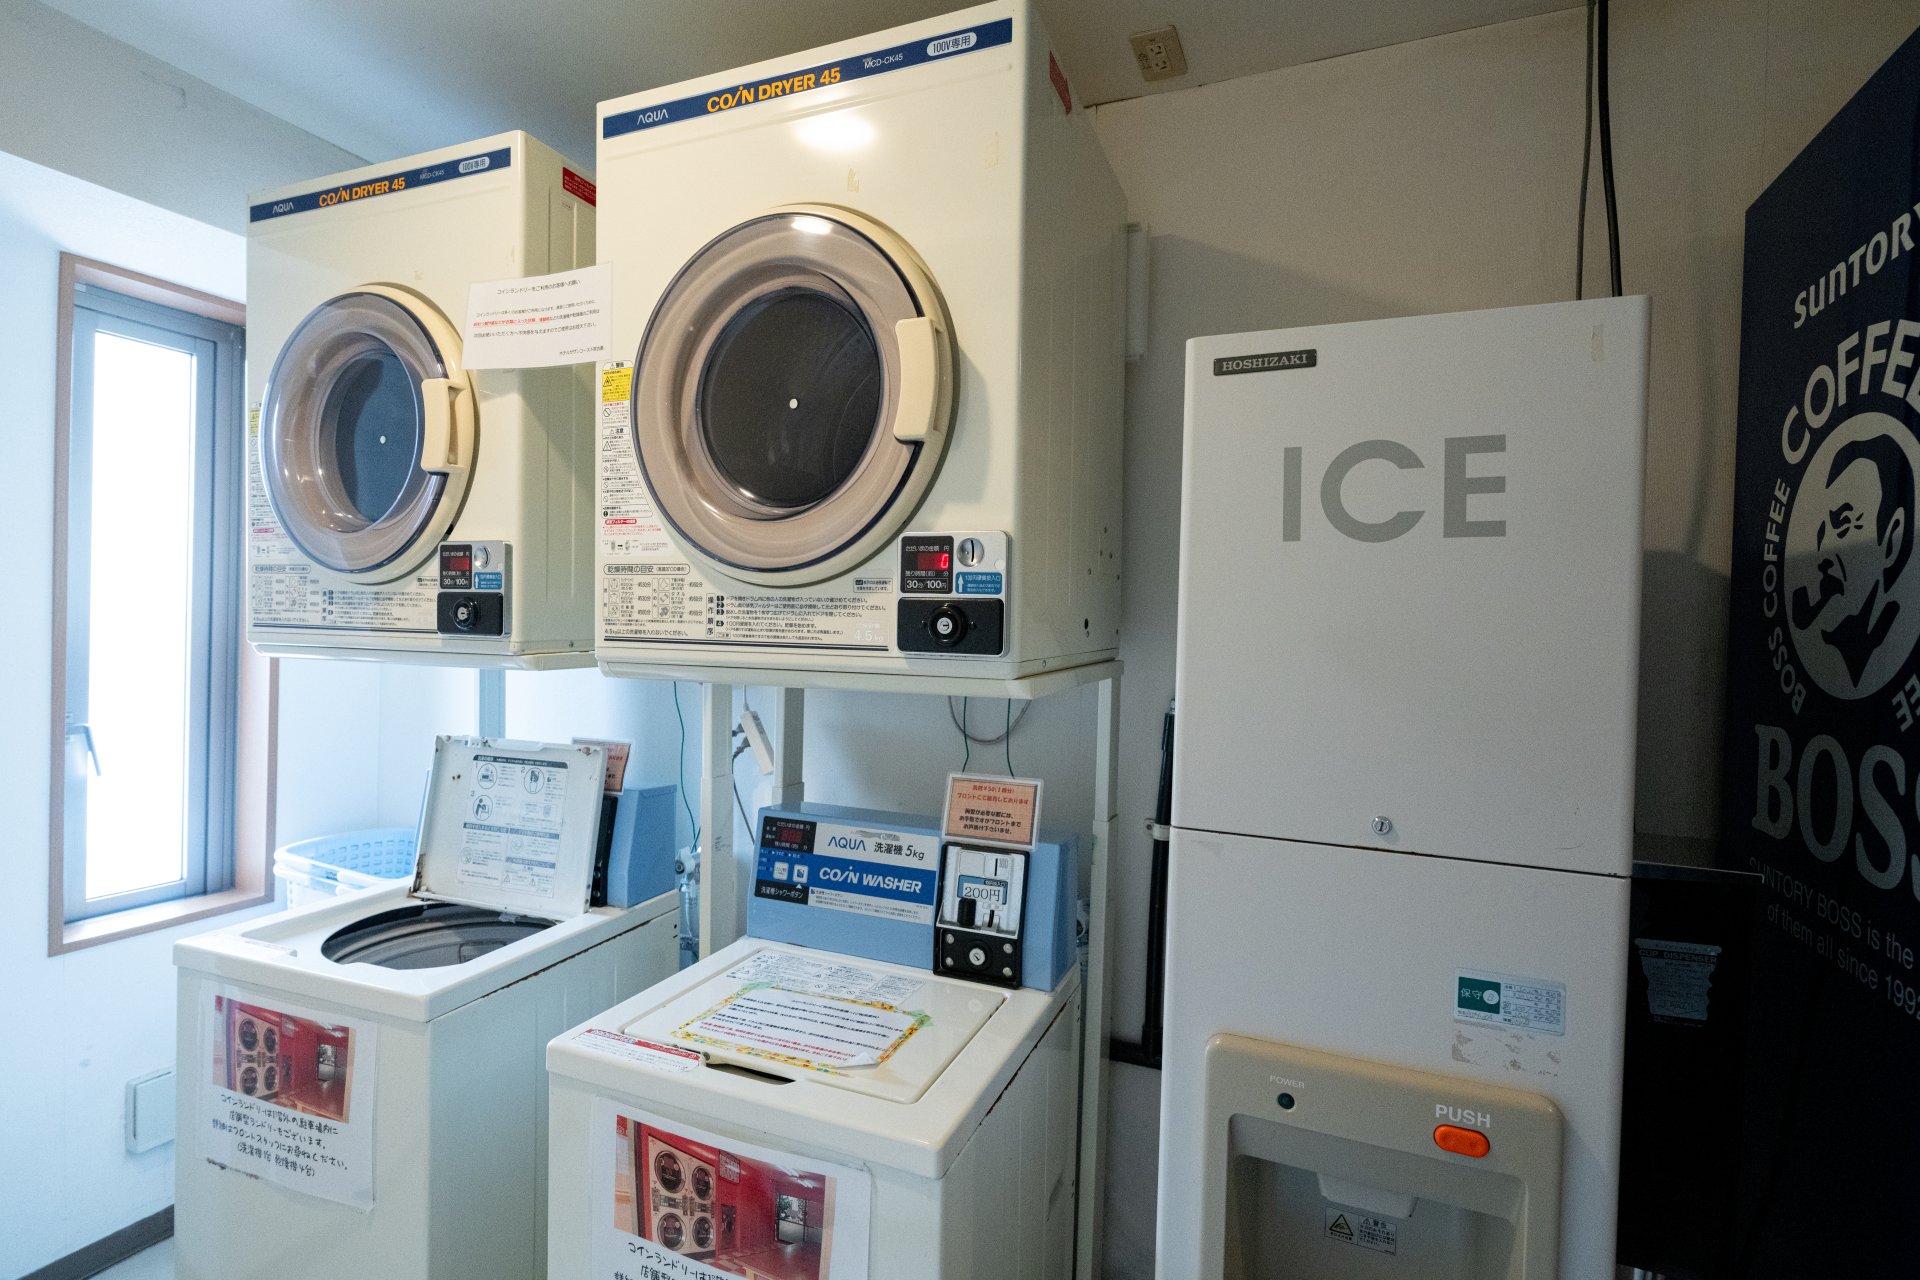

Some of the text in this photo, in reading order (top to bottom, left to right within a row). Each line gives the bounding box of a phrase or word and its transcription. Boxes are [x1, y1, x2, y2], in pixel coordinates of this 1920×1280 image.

[933, 35, 970, 54] 100V専用
[864, 53, 903, 69] MCD-CK45
[707, 67, 840, 112] COIN DRYER 45
[637, 108, 668, 126] AQUA
[319, 176, 405, 207] COIN DRYER 45
[272, 202, 294, 214] AQUA
[1222, 353, 1308, 372] HOSHIZAKI
[1282, 434, 1506, 543] ICE
[1762, 478, 1791, 618] COFFEE
[608, 566, 653, 574] 乾燥時間の目安
[941, 554, 949, 568] 0
[906, 580, 947, 589] 30分 100円
[1752, 724, 1920, 903] BOS
[828, 836, 866, 851] AQUA
[874, 842, 925, 861] 洗濯機 5kg
[819, 866, 922, 894] COIN WASHER
[964, 886, 1000, 901] 200円
[1817, 894, 1862, 938] BOSS
[1868, 920, 1880, 950] is
[1886, 930, 1914, 970] the
[1768, 904, 1920, 1022] of them all since 199
[1270, 1075, 1305, 1088] POWER
[1435, 1104, 1491, 1128] PUSH
